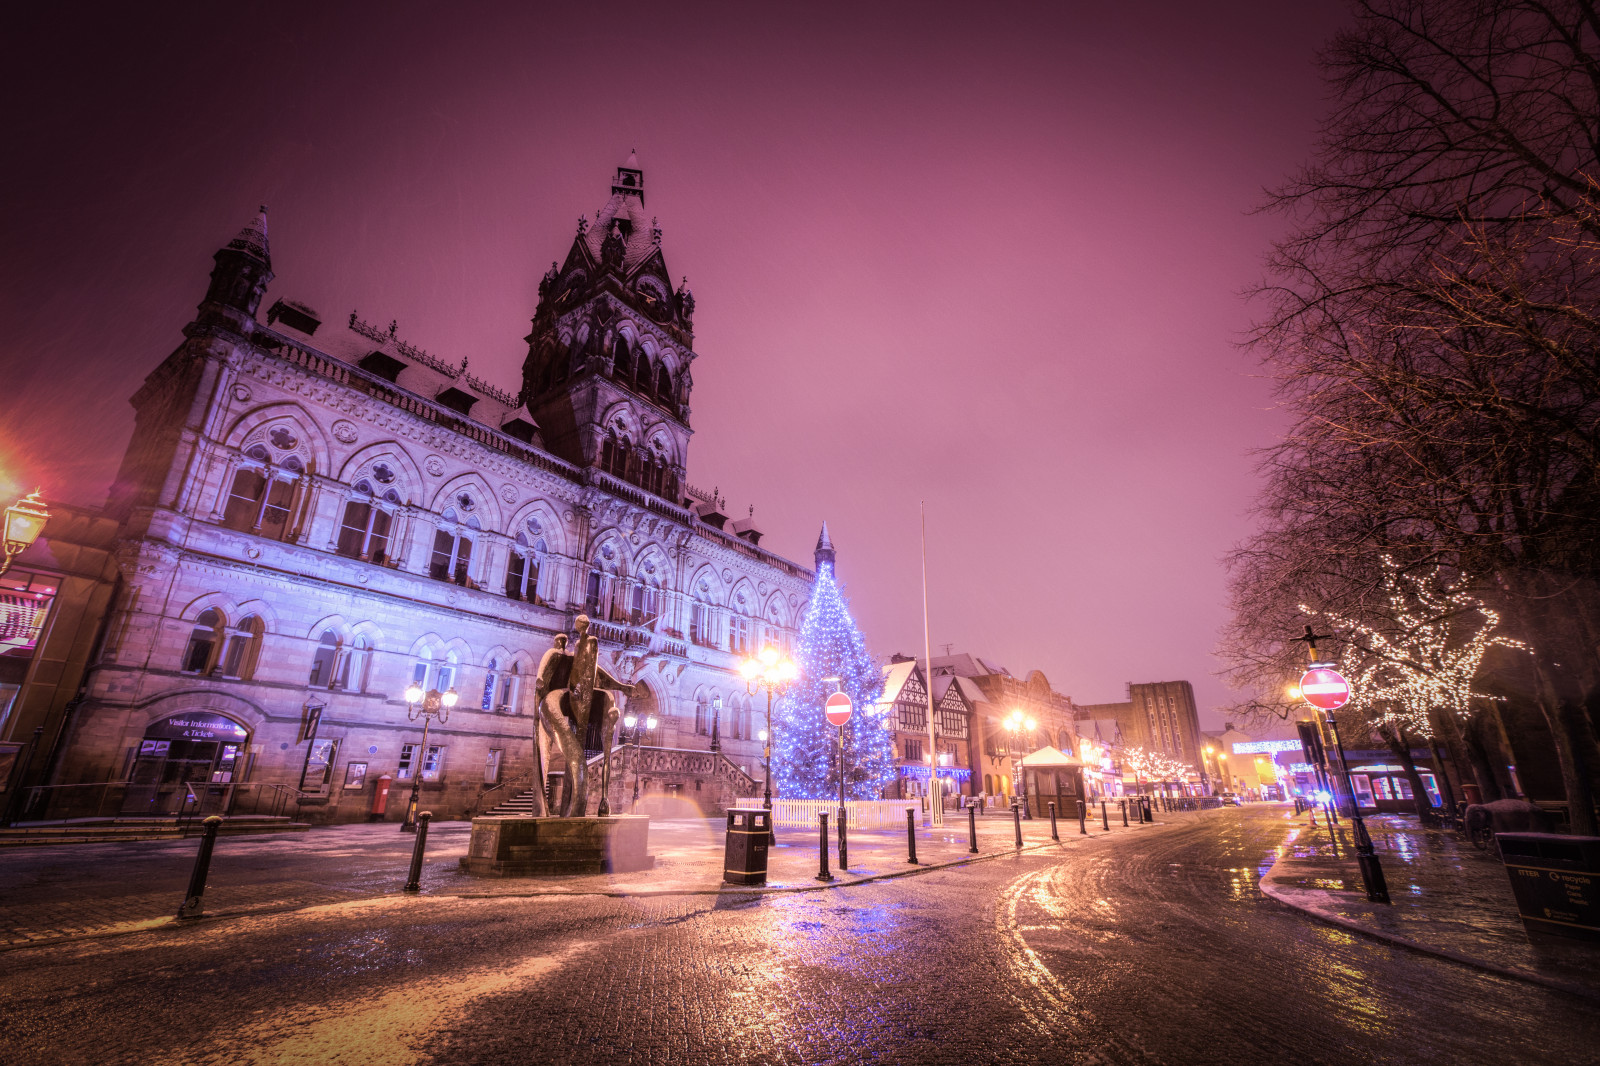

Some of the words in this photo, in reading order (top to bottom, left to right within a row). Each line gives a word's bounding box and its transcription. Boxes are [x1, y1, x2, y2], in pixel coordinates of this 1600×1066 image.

[169, 719, 190, 727] Visitor
[190, 720, 231, 730] Information
[307, 710, 319, 738] i
[191, 729, 215, 738] Tickets
[1562, 875, 1591, 884] recycle
